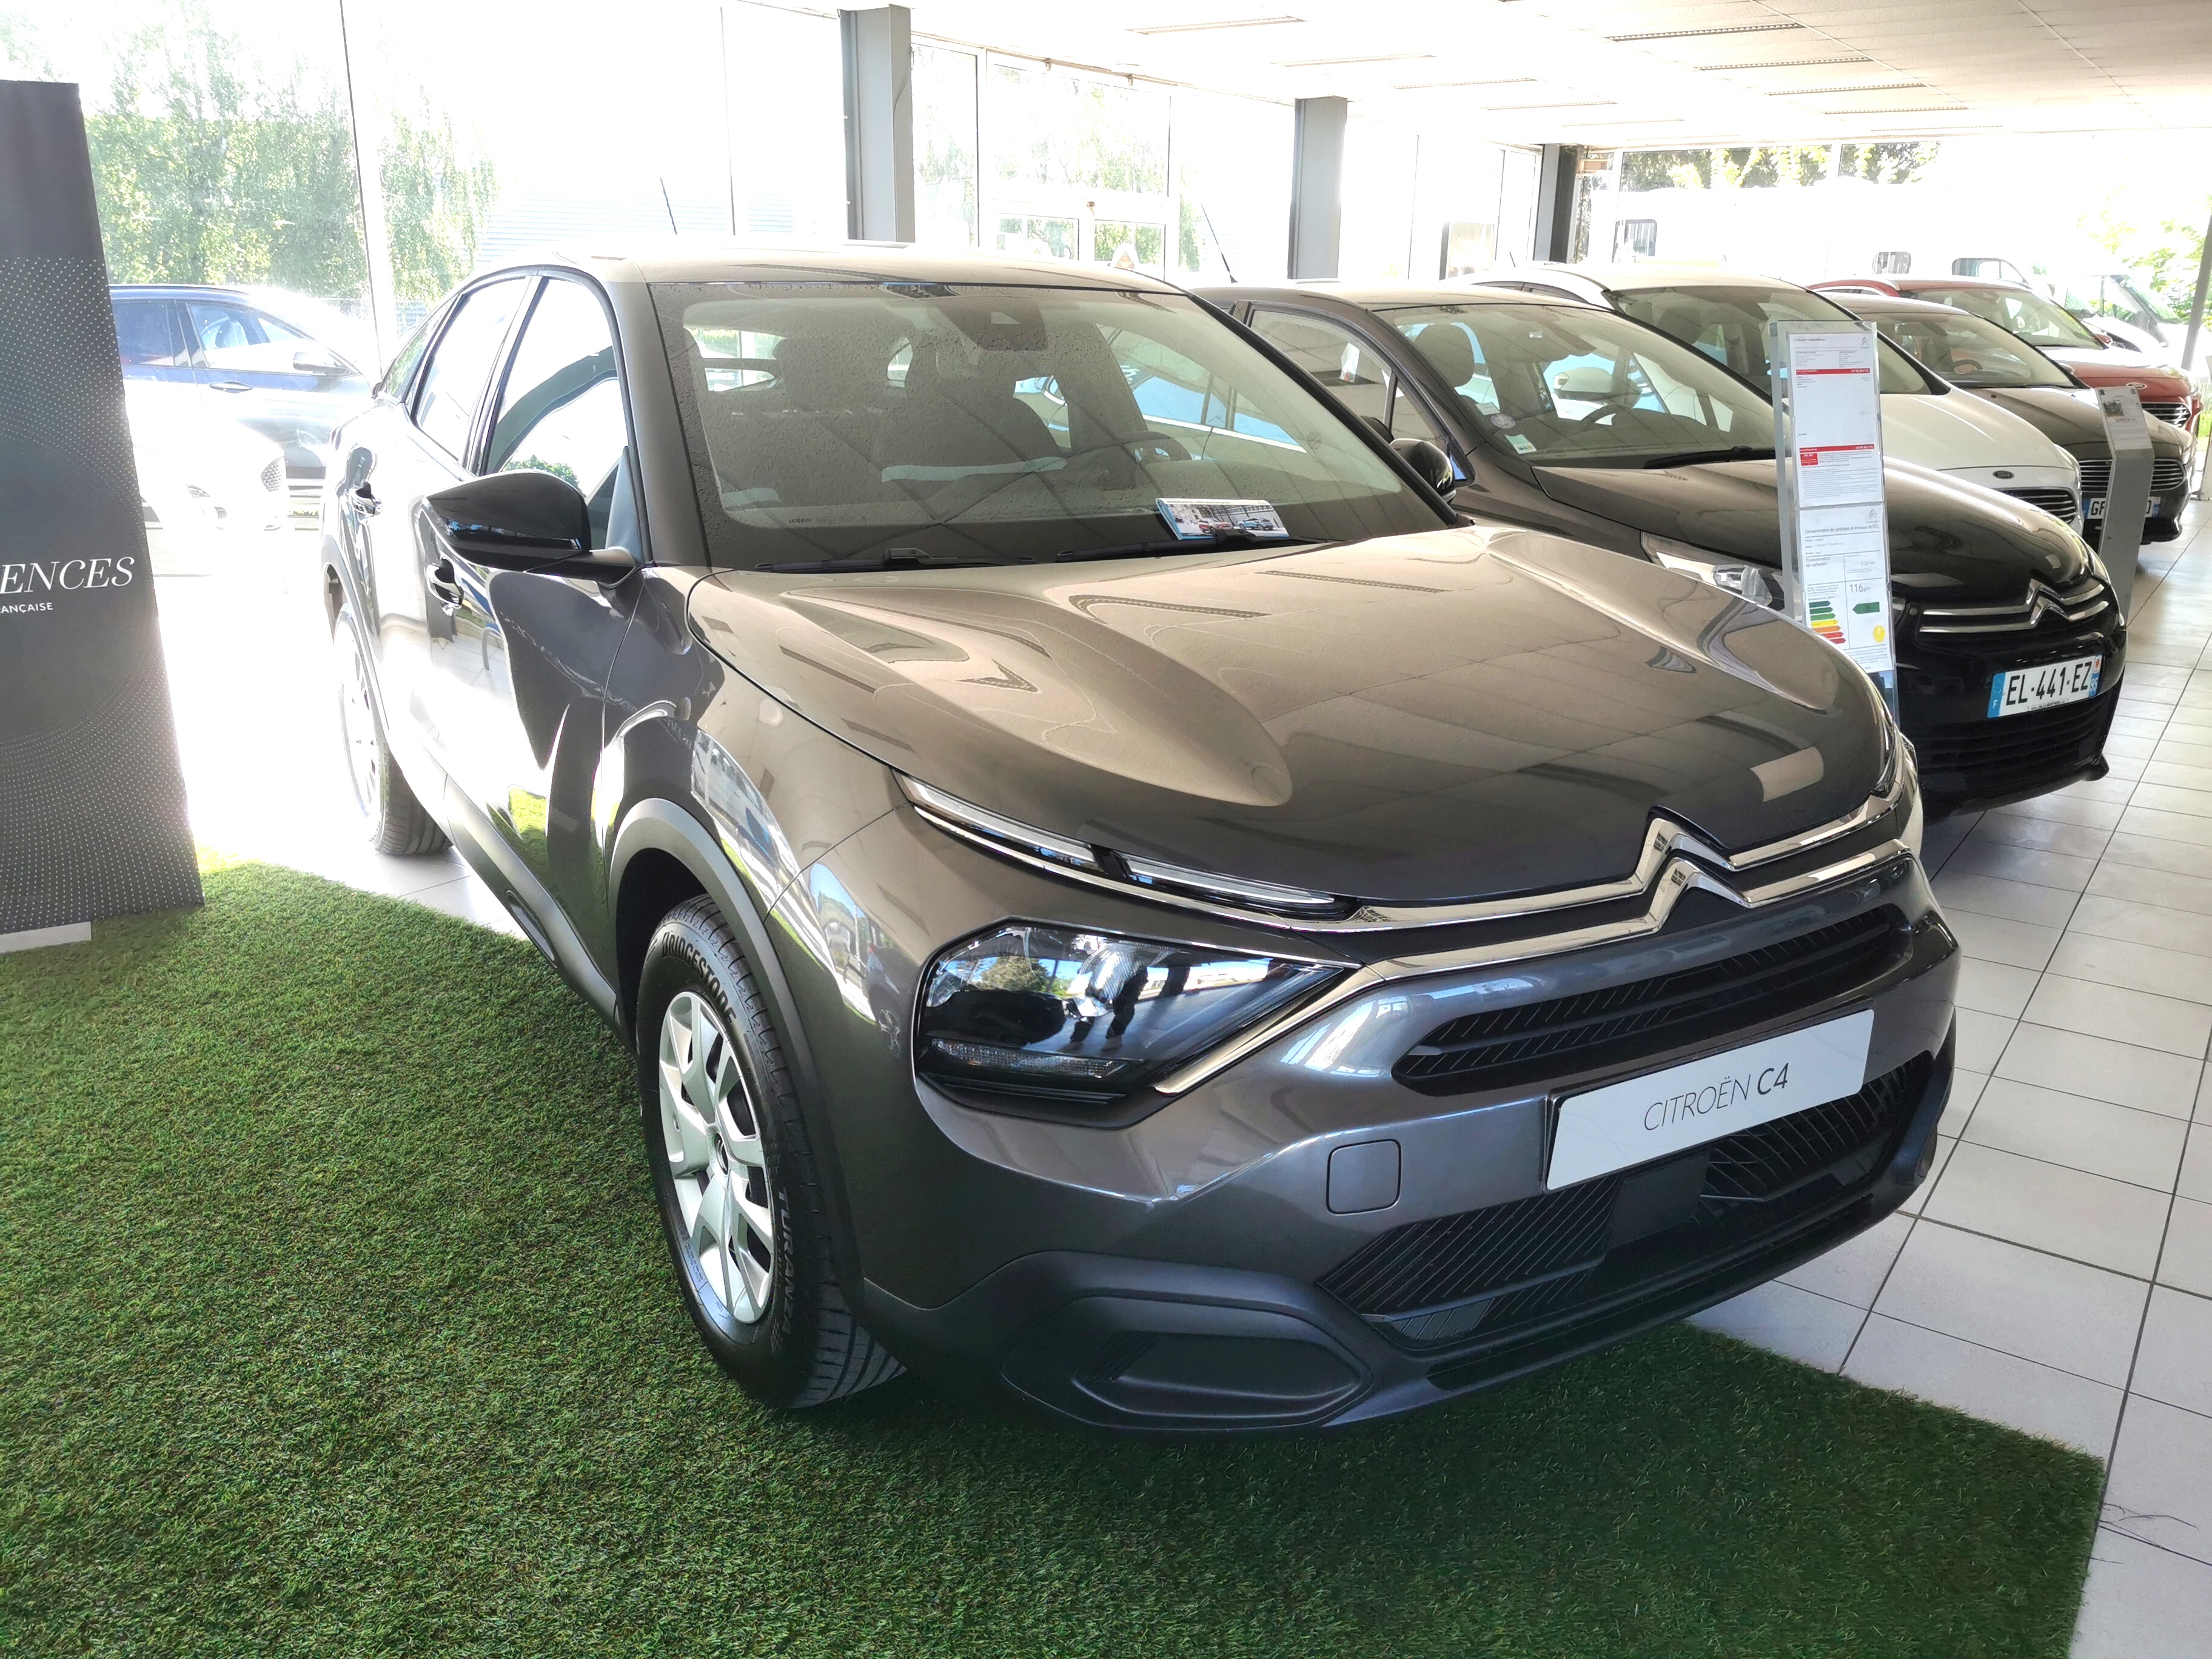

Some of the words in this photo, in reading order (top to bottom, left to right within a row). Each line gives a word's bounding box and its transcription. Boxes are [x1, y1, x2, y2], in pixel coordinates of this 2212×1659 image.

[1849, 583, 1863, 593] 116
[1644, 1074, 1751, 1130] CITROËN
[1757, 1063, 1789, 1095] C4
